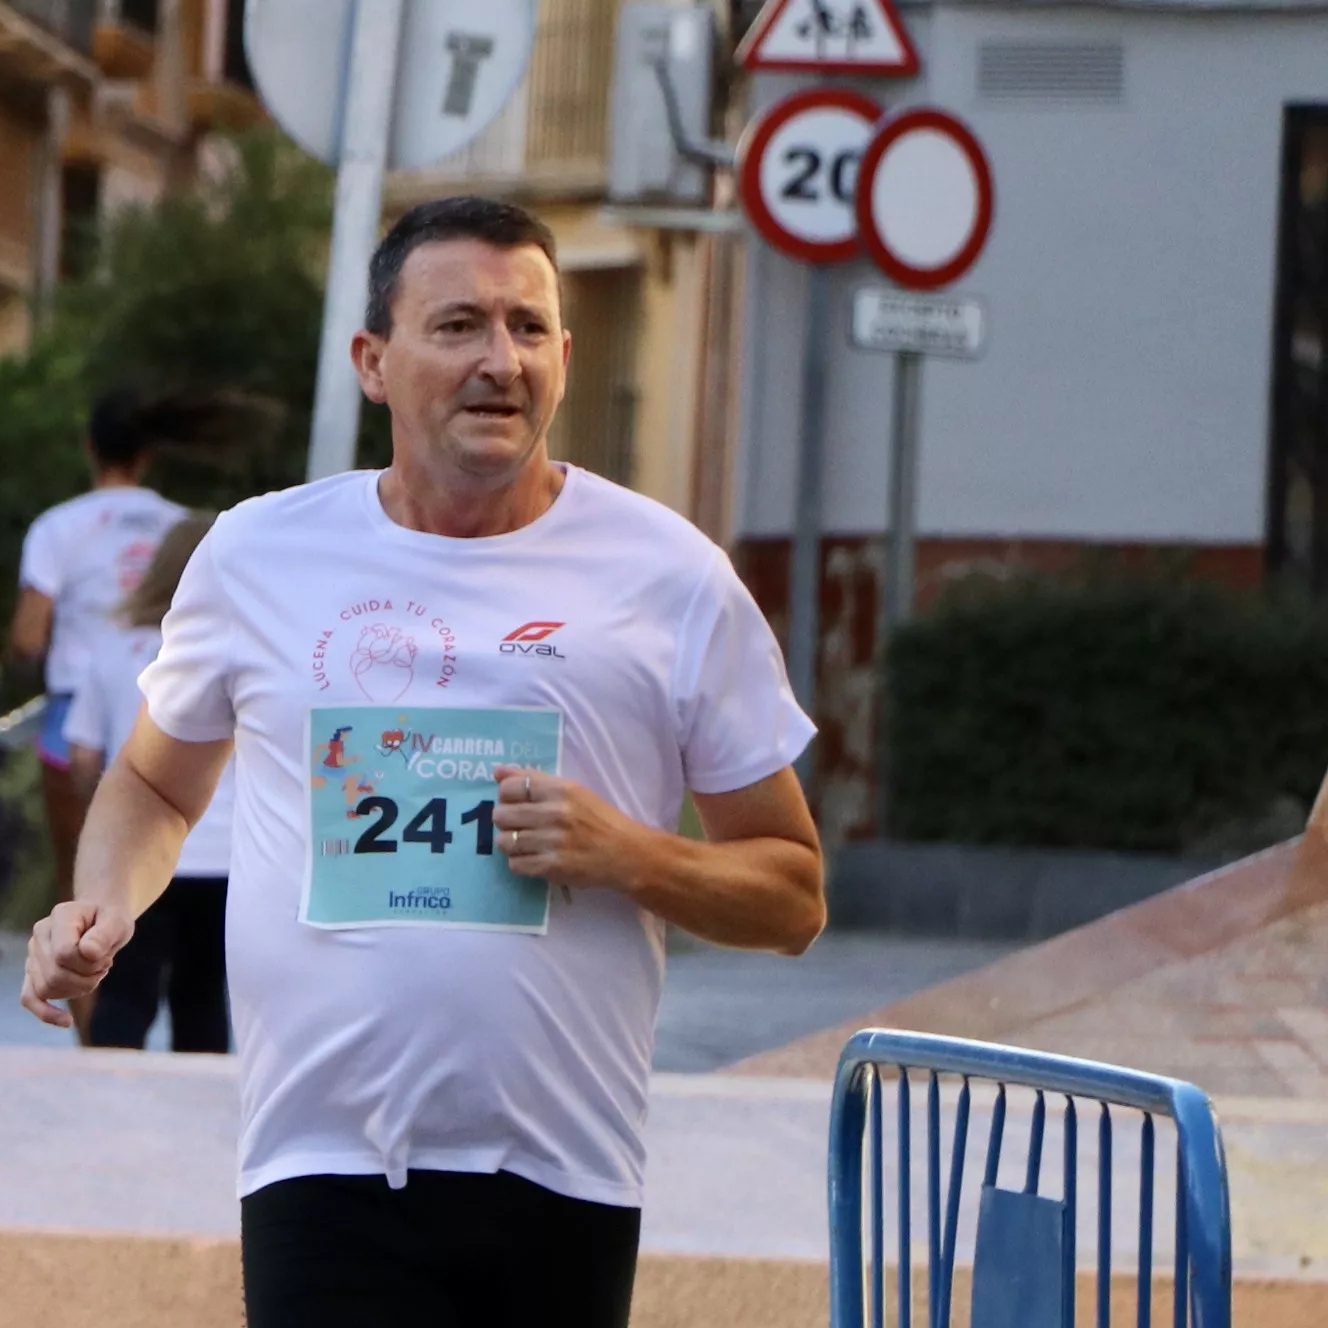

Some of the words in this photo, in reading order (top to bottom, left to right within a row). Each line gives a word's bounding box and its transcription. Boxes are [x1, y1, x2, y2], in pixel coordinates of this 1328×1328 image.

[780, 148, 862, 206] 20
[312, 629, 335, 691] LUCENA
[340, 600, 394, 621] CUIDA
[406, 601, 427, 617] TU
[432, 737, 504, 756] CARRERA
[417, 758, 542, 781] CORA
[354, 796, 496, 856] 241
[389, 890, 451, 909] Infrico
